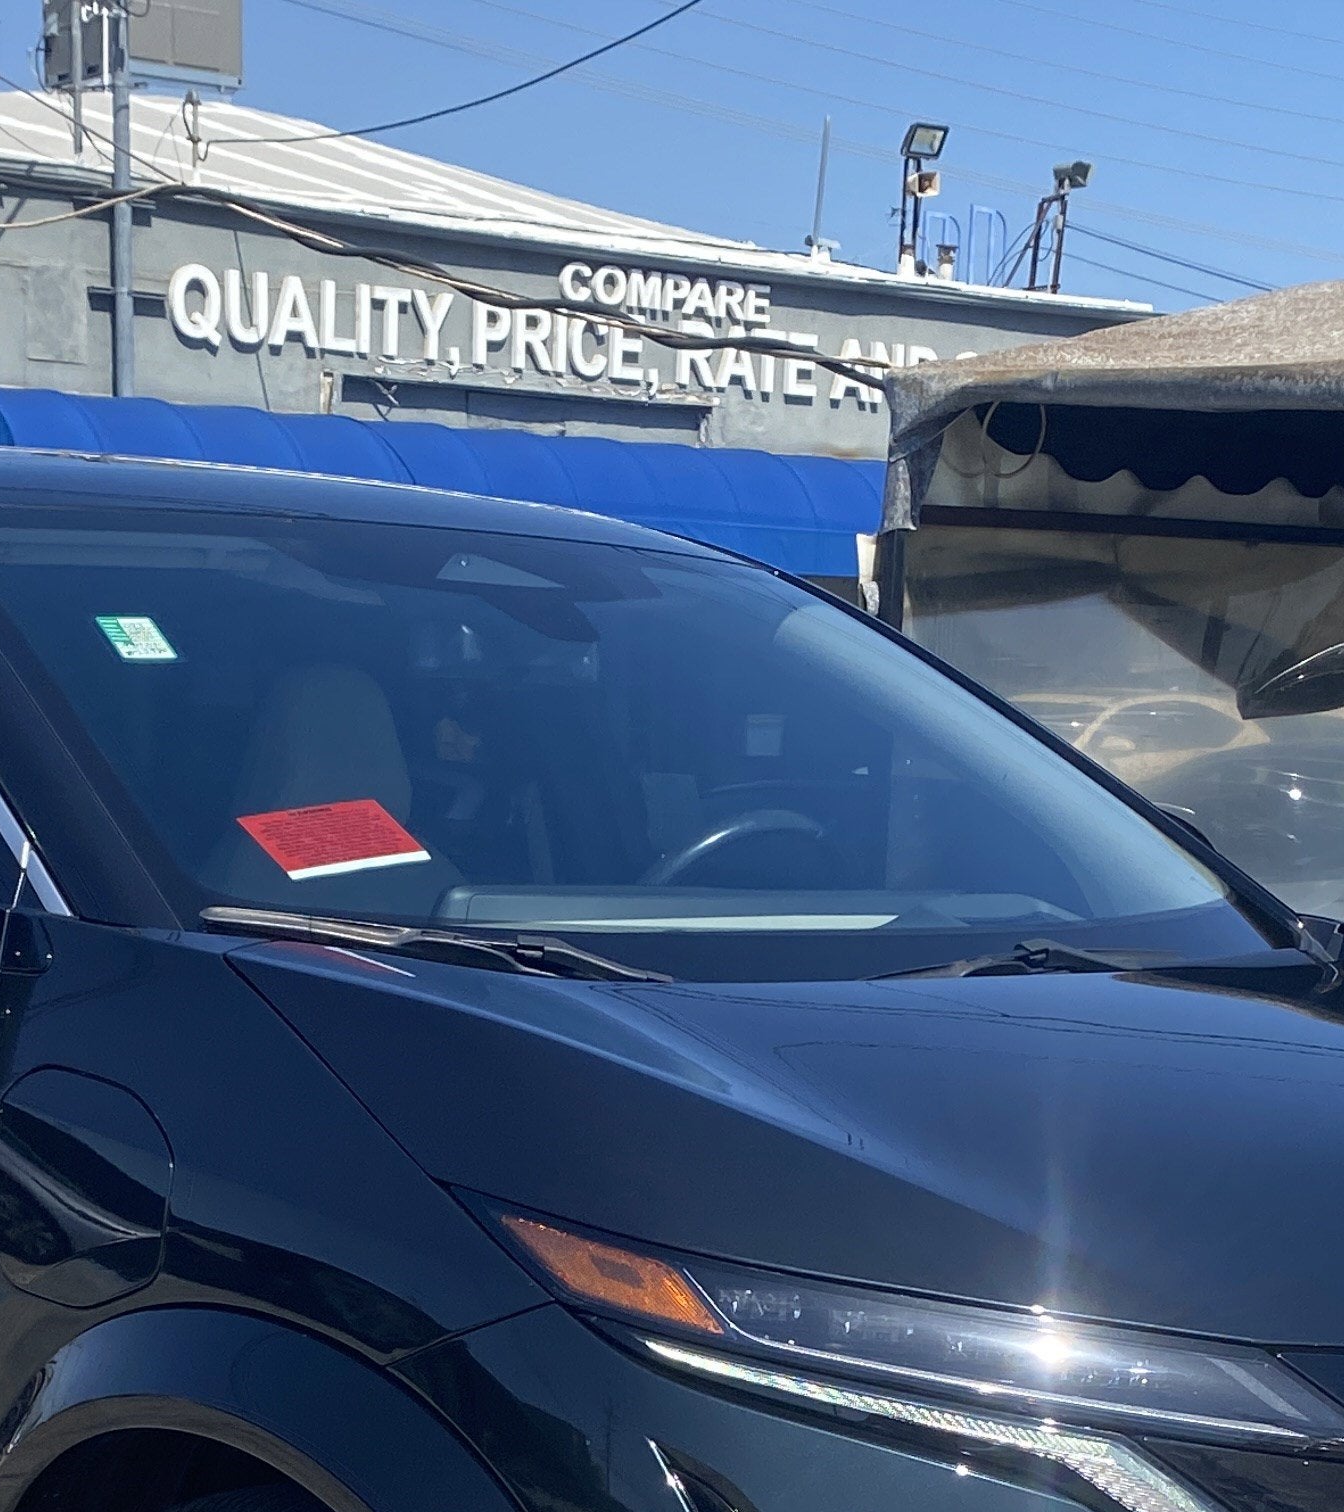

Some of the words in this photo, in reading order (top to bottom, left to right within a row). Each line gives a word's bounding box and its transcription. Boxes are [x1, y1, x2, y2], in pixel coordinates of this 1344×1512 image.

[167, 263, 460, 376] QUALITY,
[471, 300, 658, 396] PRICE,
[675, 317, 819, 398] RATE
[558, 261, 771, 323] COMPARE
